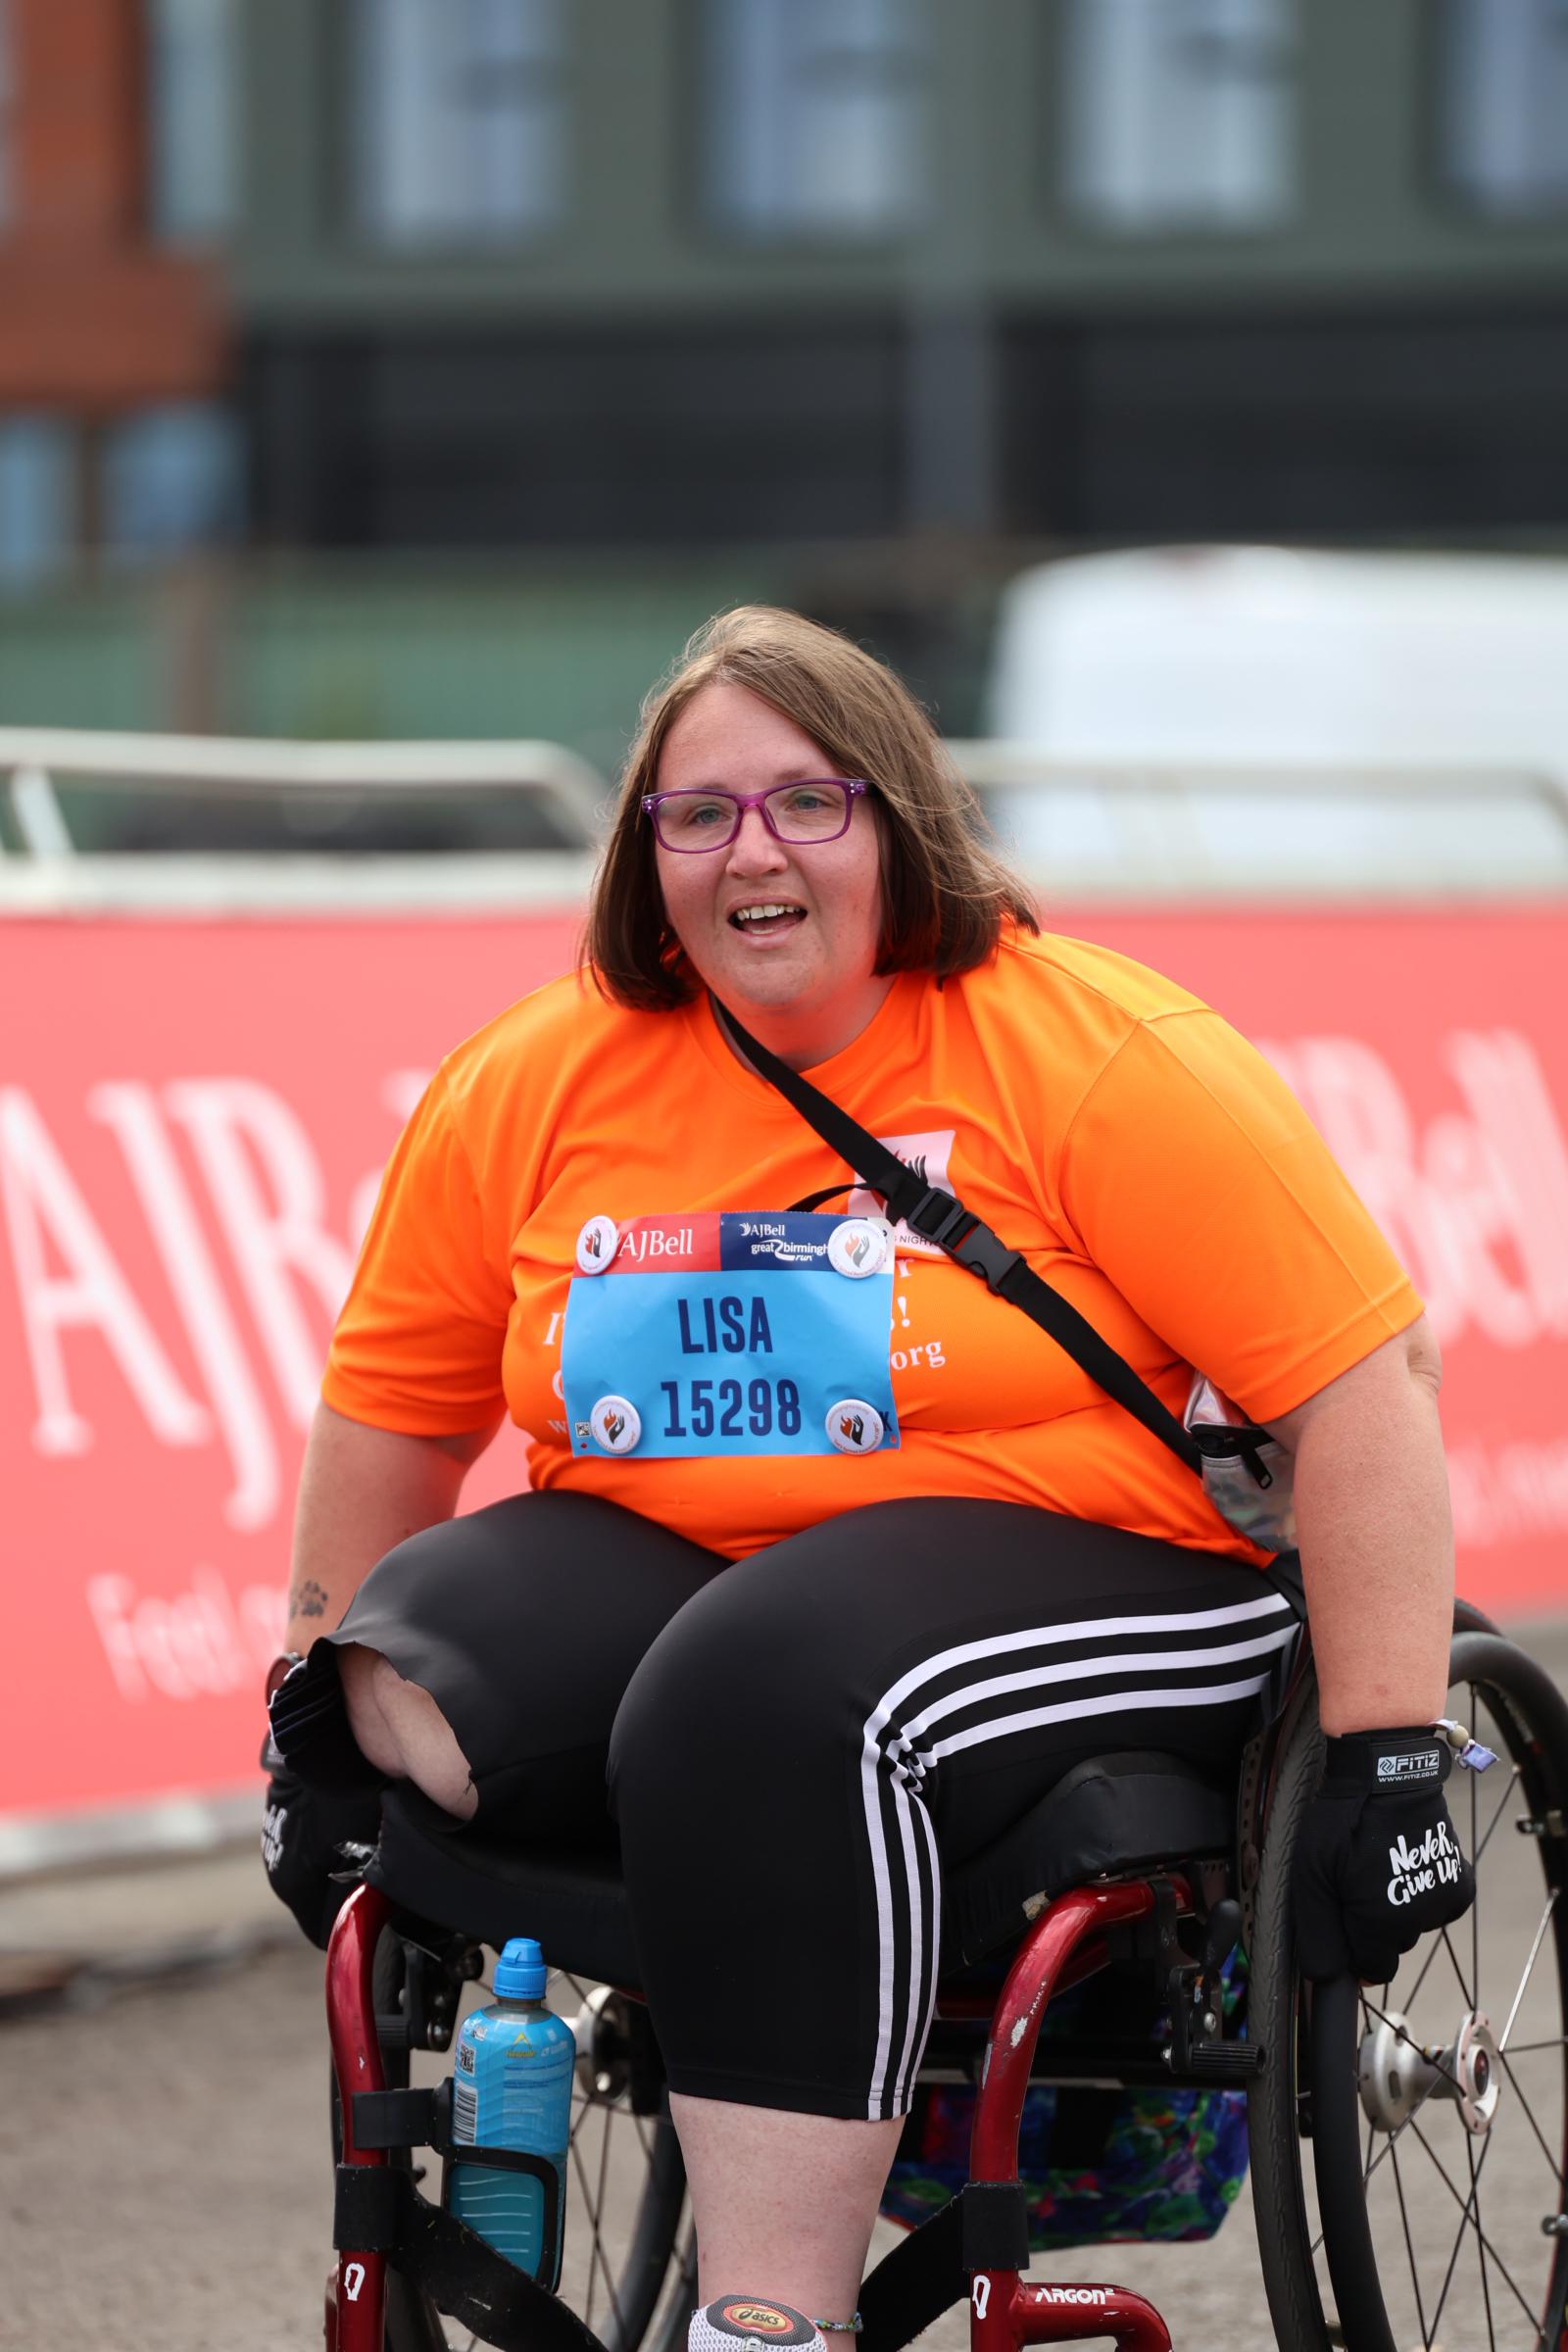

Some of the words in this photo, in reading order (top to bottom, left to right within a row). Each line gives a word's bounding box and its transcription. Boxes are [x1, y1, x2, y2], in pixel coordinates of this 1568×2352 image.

[617, 1228, 694, 1262] AJBell
[750, 1223, 786, 1238] AJBell
[751, 1243, 775, 1254] great
[783, 1241, 828, 1256] birmingh
[677, 1296, 773, 1354] LISA
[661, 1378, 802, 1438] 15298
